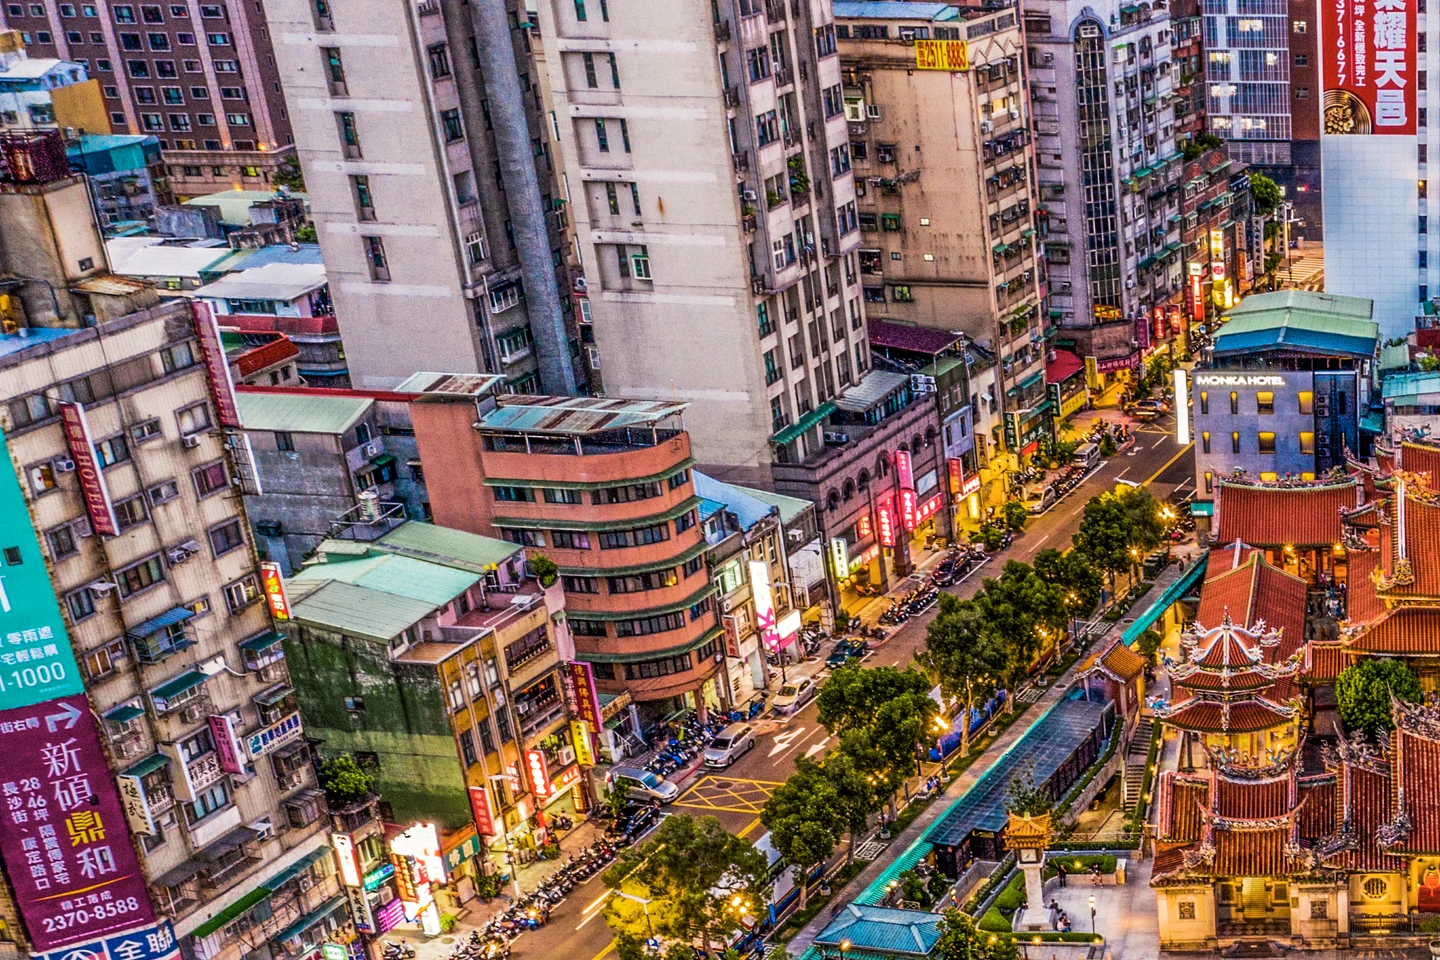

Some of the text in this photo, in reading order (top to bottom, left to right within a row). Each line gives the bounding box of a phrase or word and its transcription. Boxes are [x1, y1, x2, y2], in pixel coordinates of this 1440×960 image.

[925, 41, 966, 67] 2511-8883
[1197, 376, 1285, 385] MONKA HOTEL
[78, 455, 104, 515] HOTEL
[2, 781, 51, 891] 長沙街、康定路口
[42, 896, 140, 934] 2370-8588
